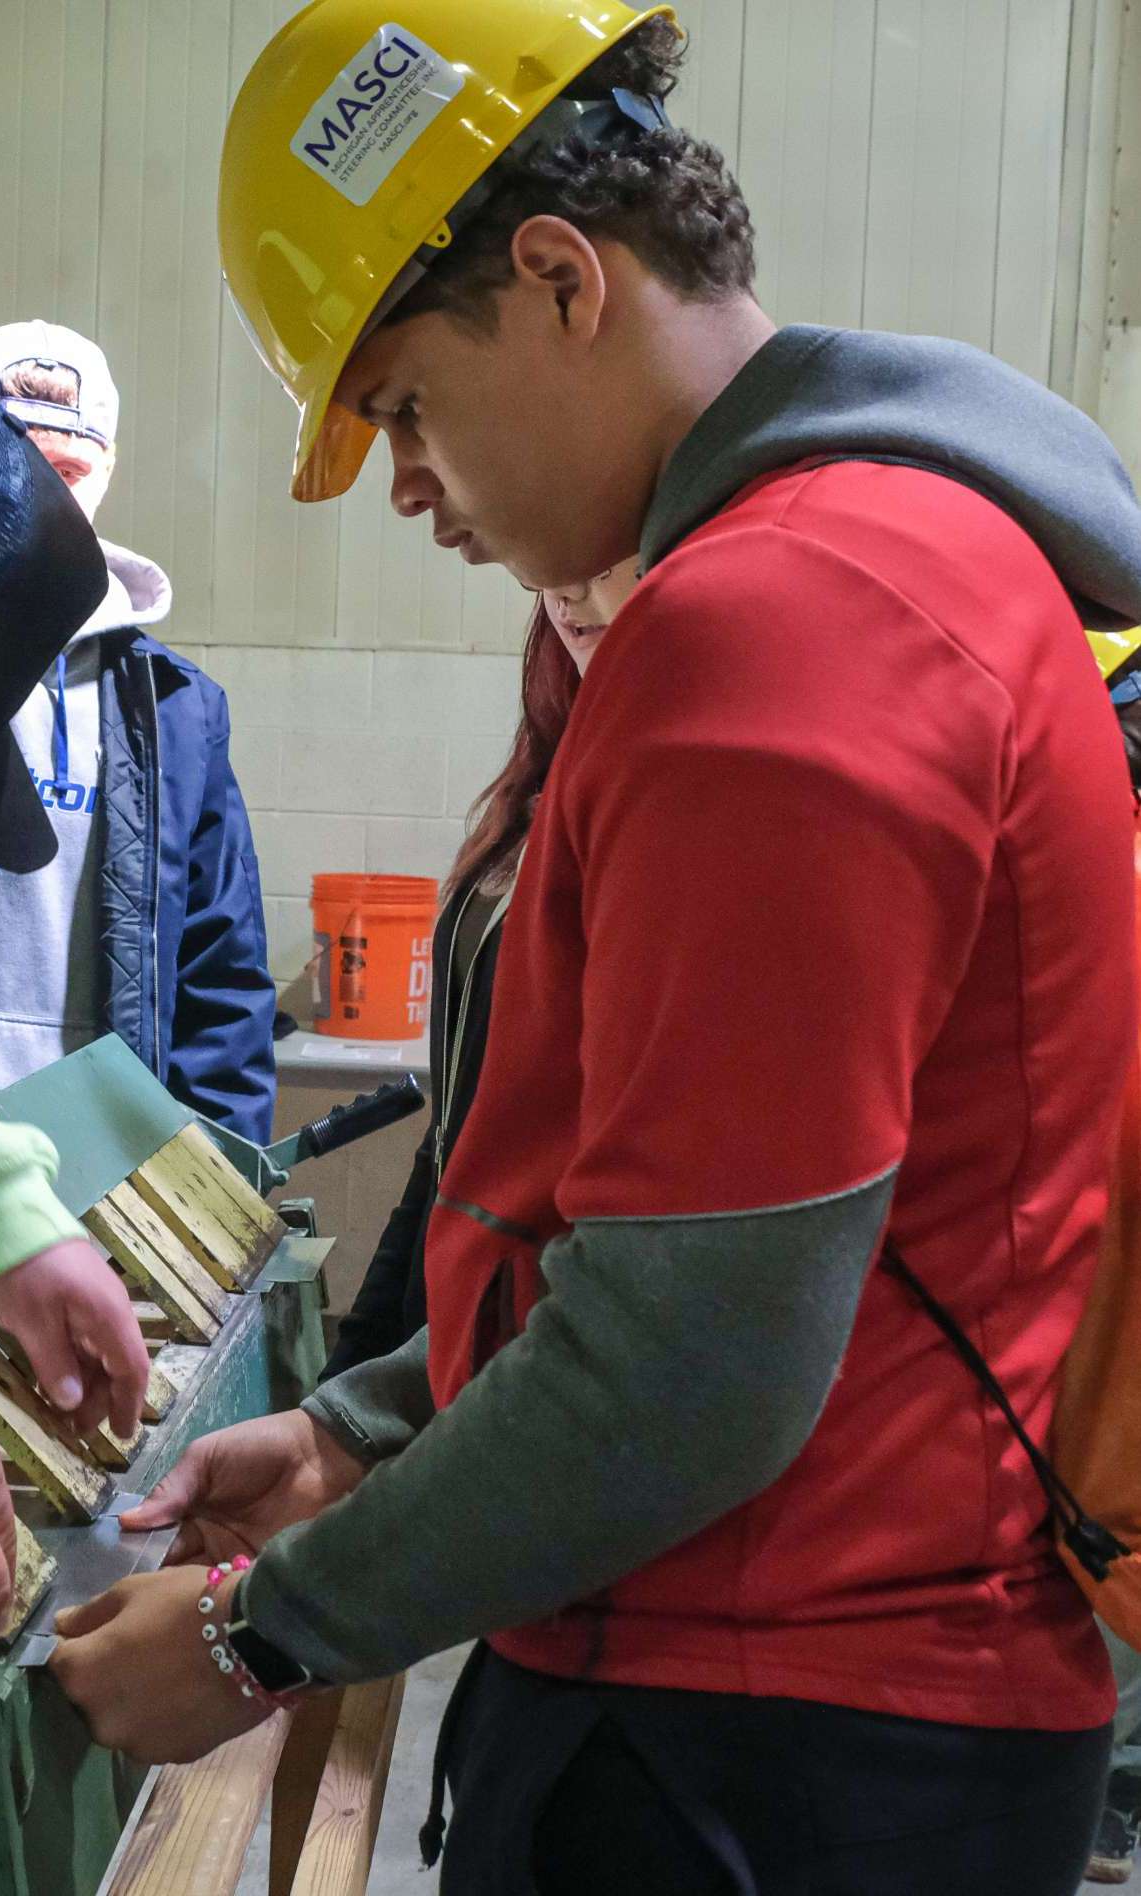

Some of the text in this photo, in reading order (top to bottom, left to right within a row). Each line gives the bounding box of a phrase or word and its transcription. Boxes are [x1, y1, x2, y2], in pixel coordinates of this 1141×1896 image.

[304, 36, 420, 167] MASCI
[330, 58, 428, 175] MICHIGAN APPRENTICESHIP
[339, 136, 376, 183] STEERING
